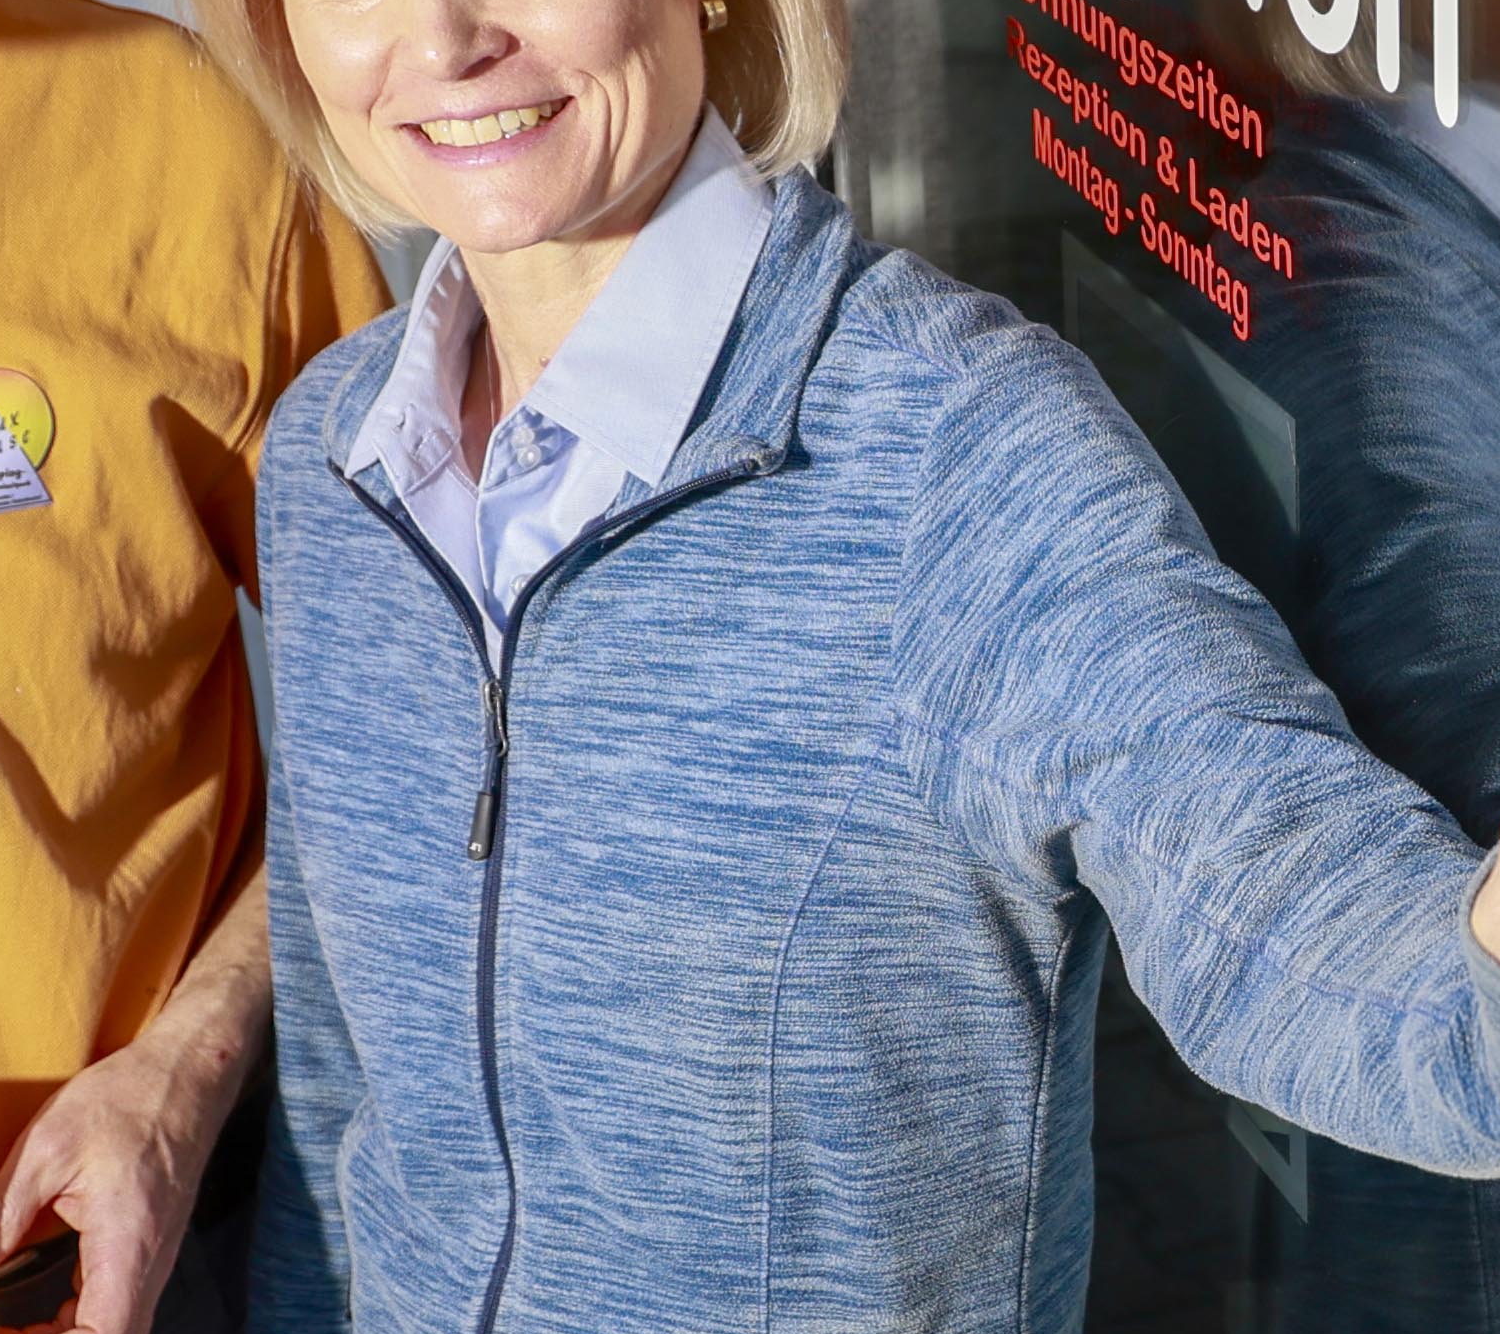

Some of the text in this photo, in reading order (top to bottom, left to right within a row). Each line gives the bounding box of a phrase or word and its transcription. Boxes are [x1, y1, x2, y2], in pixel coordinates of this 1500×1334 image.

[1007, 16, 1293, 279] Rezeption & Laden
[1032, 108, 1120, 235] Montag
[1140, 193, 1251, 342] Sonntag
